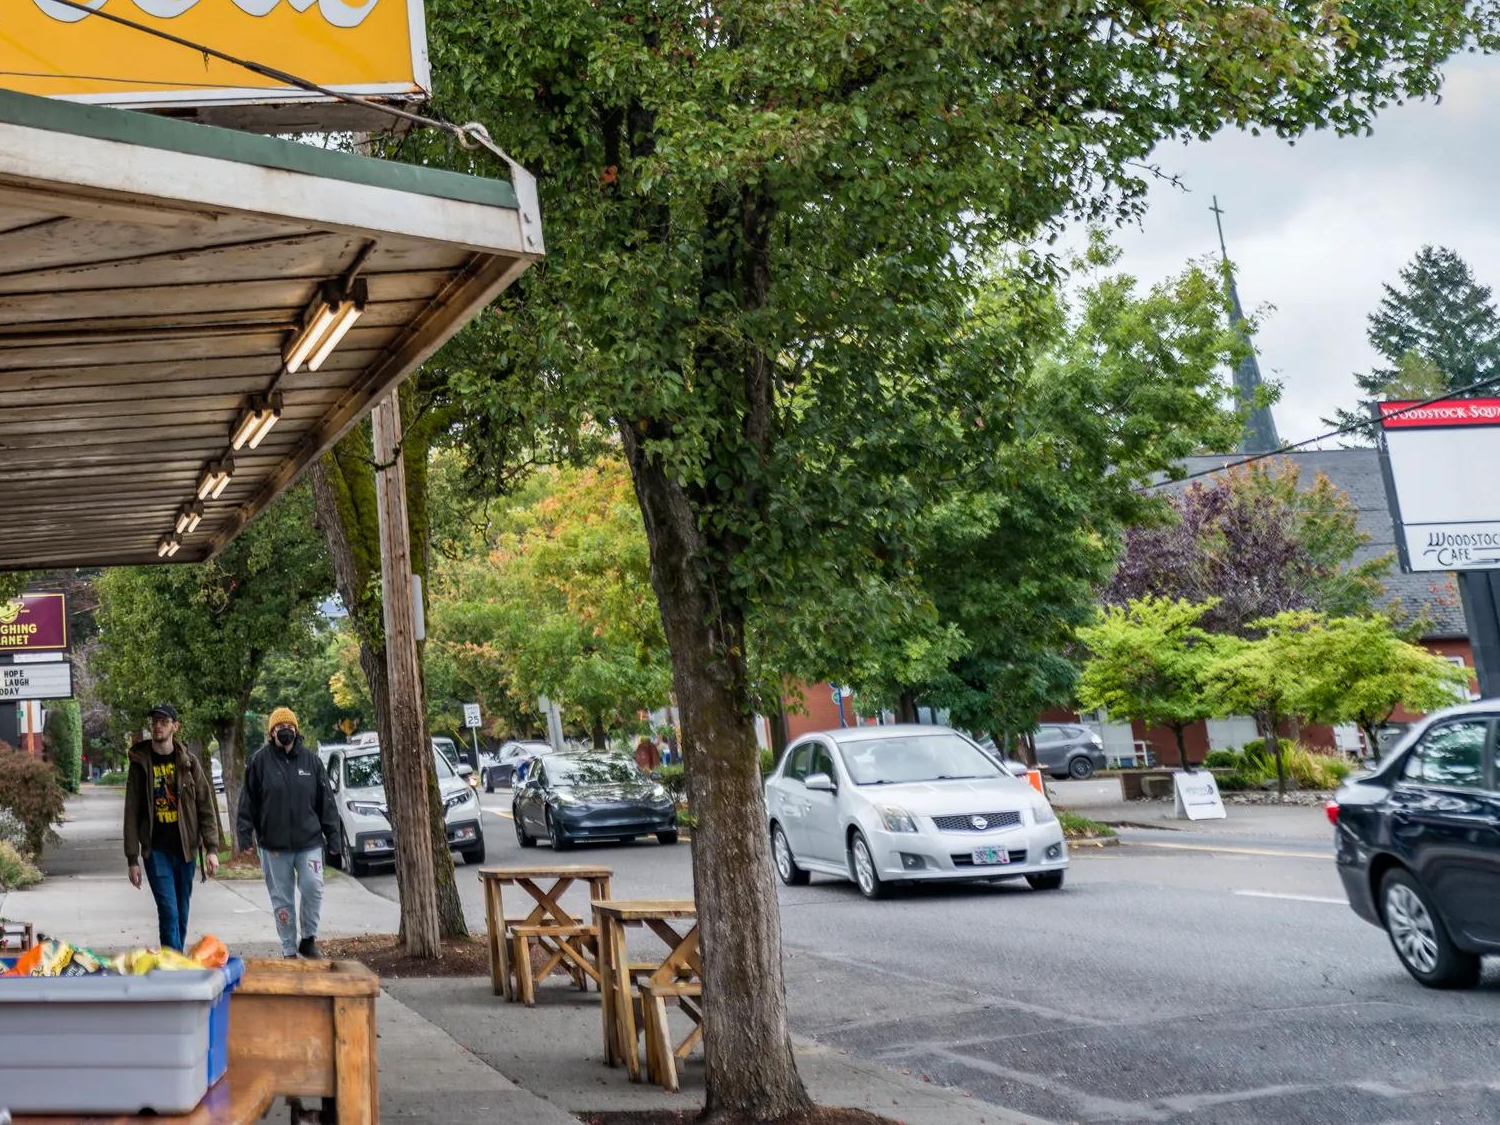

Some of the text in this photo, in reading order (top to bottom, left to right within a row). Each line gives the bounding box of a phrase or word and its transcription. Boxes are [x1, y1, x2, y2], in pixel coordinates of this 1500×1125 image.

[1427, 532, 1500, 546] WOODSTOC
[4, 670, 24, 679] HOPE
[5, 679, 30, 687] LAUGH
[467, 715, 480, 725] 25
